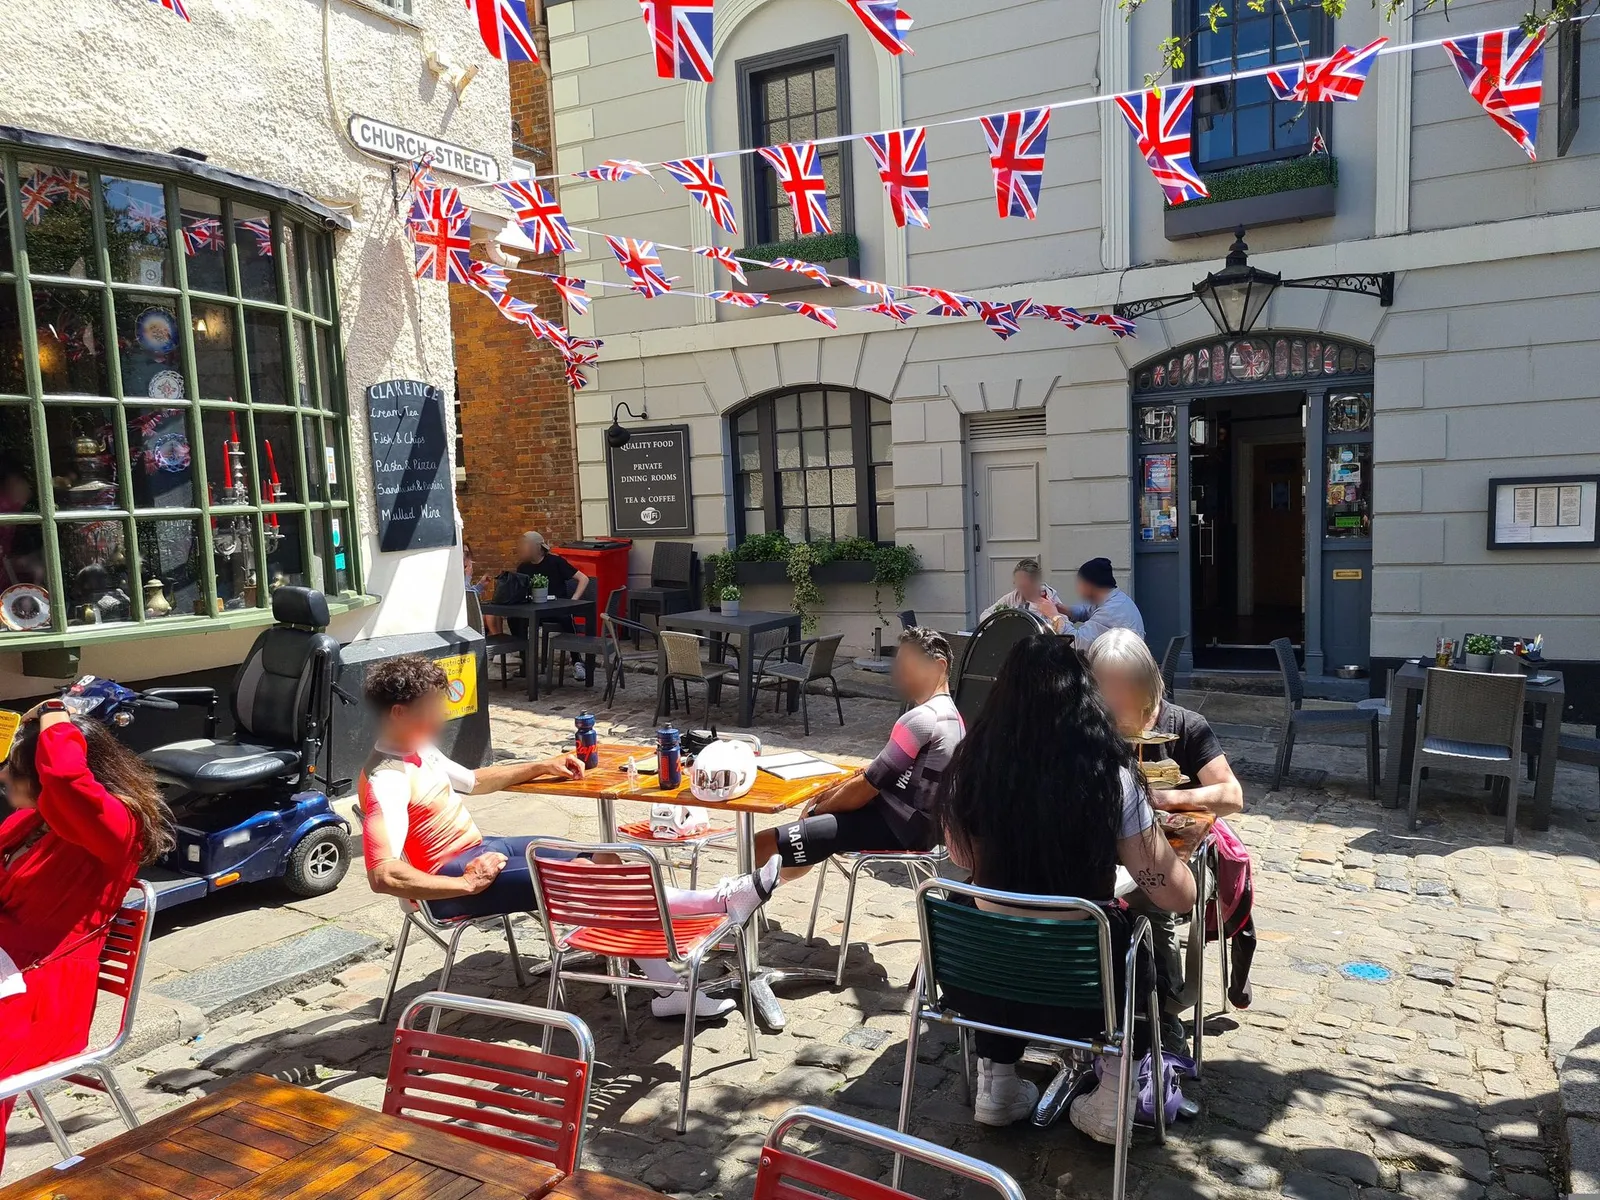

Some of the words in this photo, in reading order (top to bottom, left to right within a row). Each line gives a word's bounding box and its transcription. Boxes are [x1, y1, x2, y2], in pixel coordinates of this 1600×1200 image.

[361, 124, 427, 157] CHURCH
[436, 146, 490, 177] STREET
[370, 380, 439, 401] CLARENCE
[370, 407, 402, 418] Cream
[403, 405, 420, 417] Tea
[373, 432, 395, 445] Fish
[396, 431, 402, 444] &
[404, 431, 426, 448] Chips
[620, 441, 652, 451] QUALITY
[653, 440, 674, 449] FOOD
[375, 459, 404, 473] Pasta
[412, 458, 438, 471] Pizza
[633, 462, 663, 471] PRIVATE
[621, 474, 648, 483] DINING
[651, 473, 677, 482] ROOMS
[624, 496, 639, 504] TEA
[648, 495, 676, 503] COFFEE
[381, 507, 416, 521] Mulled
[420, 503, 441, 519] Wine
